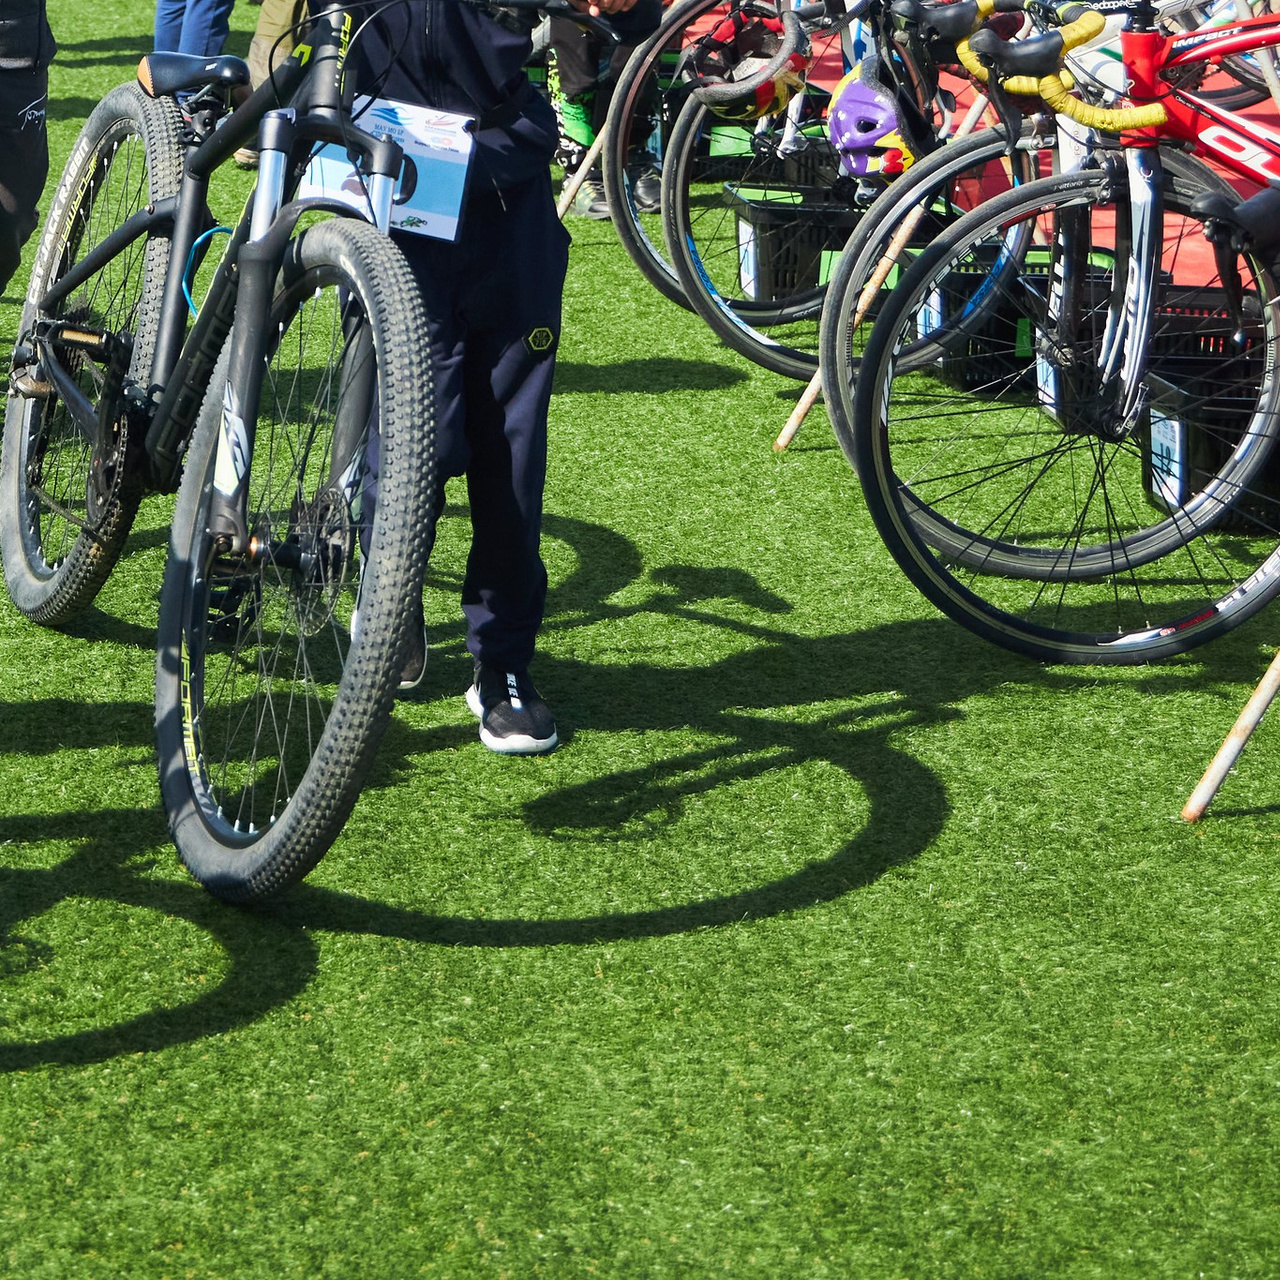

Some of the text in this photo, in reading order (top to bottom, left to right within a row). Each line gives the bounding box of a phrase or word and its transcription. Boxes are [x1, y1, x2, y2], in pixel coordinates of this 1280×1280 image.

[42, 208, 63, 262] JACK
[59, 136, 91, 206] RABBIT
[58, 167, 97, 261] FORMAT
